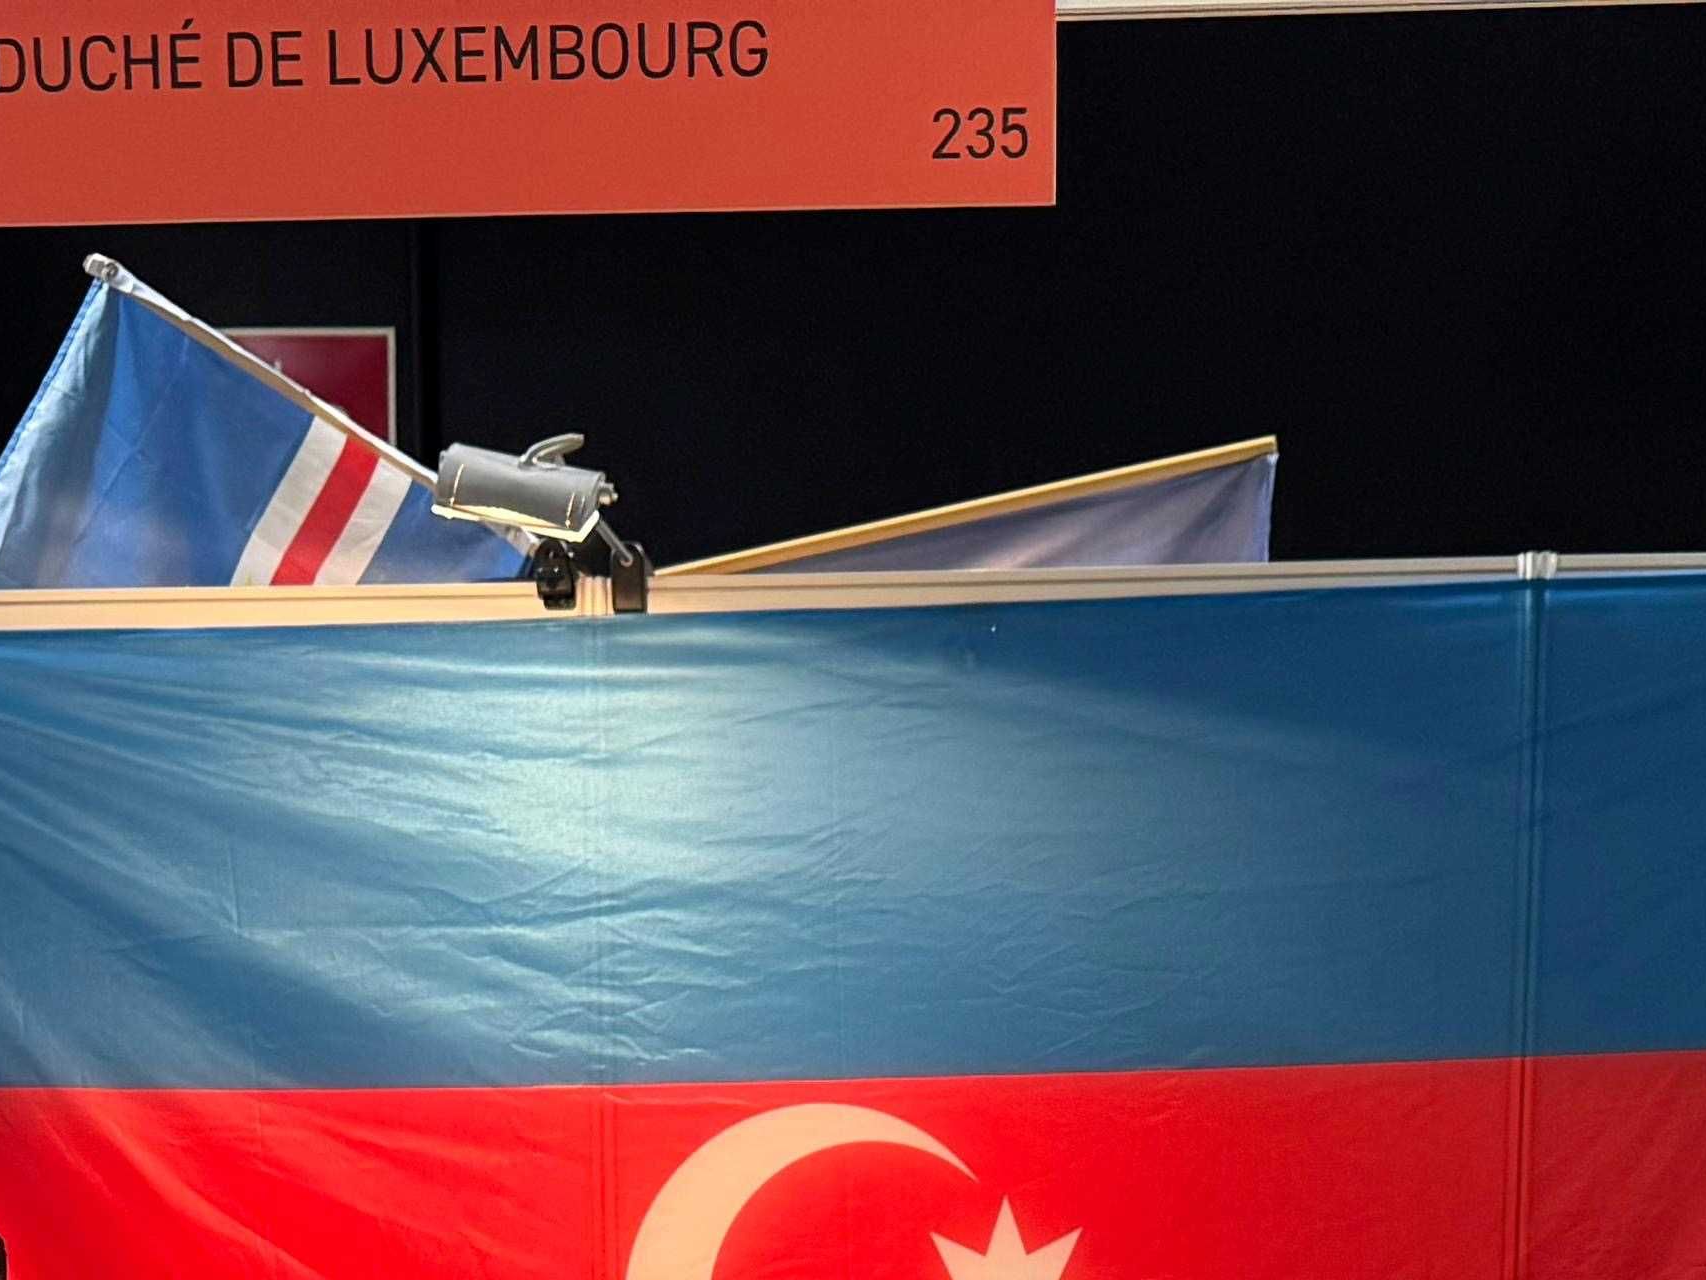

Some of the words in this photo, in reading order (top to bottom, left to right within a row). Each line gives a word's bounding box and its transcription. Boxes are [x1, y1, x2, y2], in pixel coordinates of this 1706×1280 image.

[227, 32, 303, 88] DE
[327, 20, 769, 84] LUXEMBOURG
[932, 106, 1029, 160] 235
